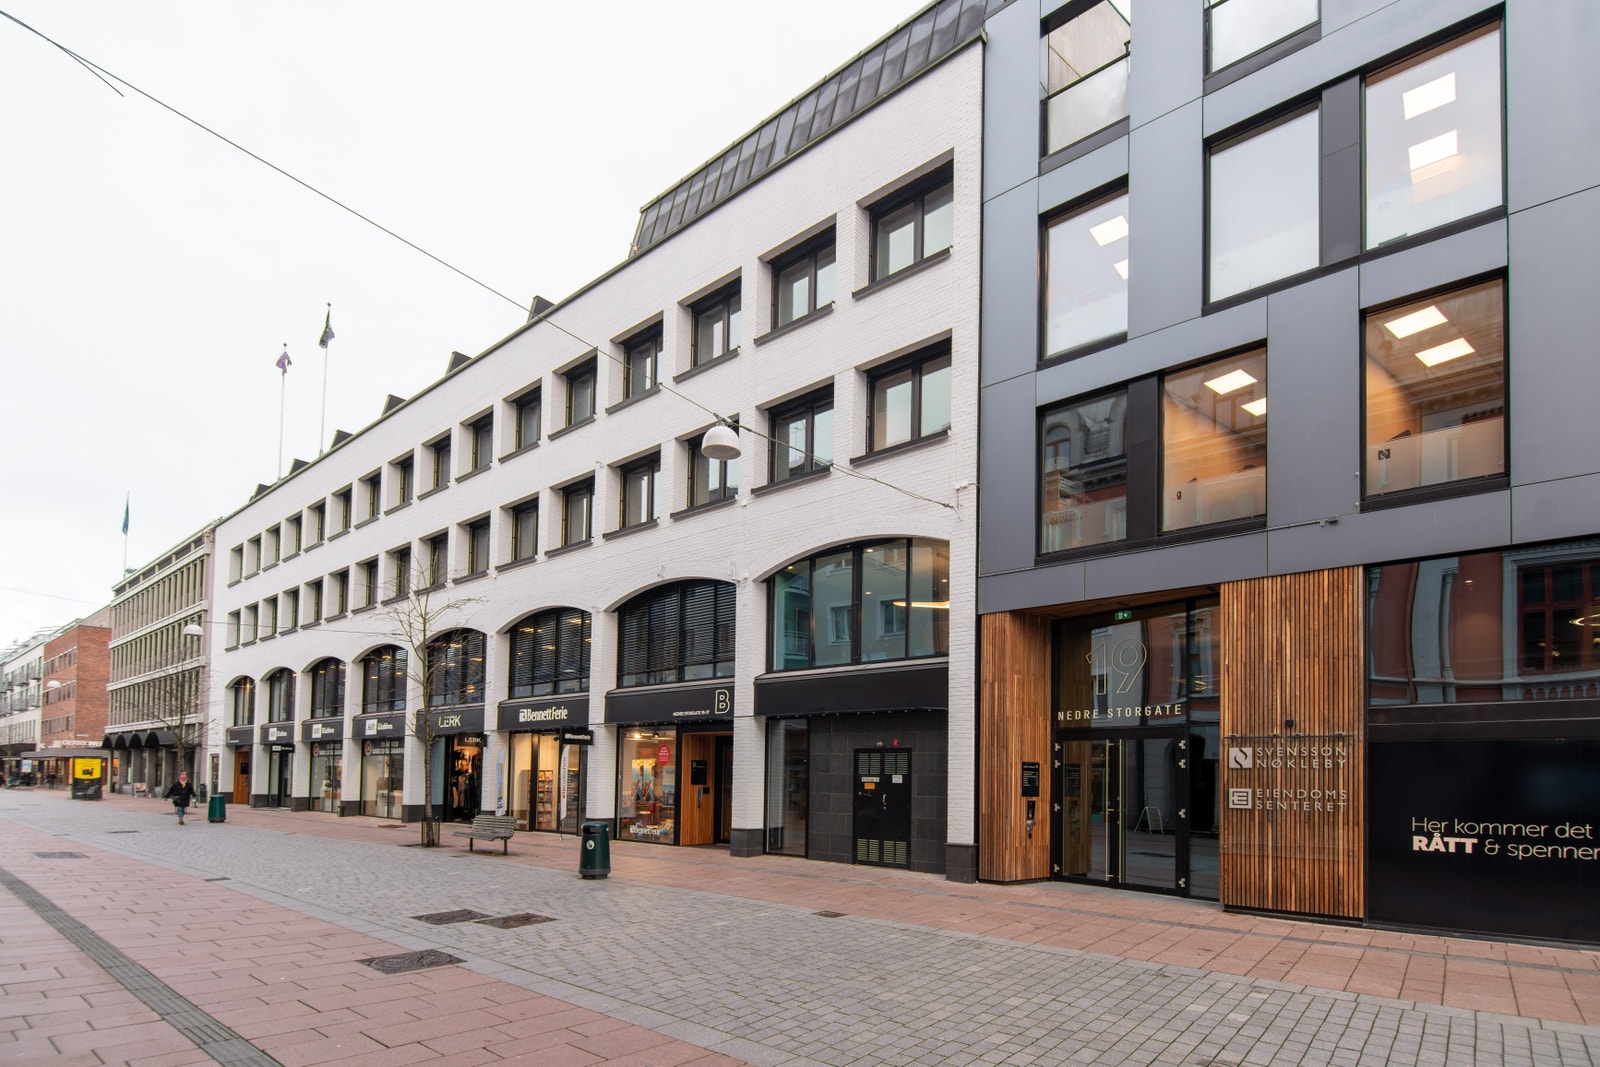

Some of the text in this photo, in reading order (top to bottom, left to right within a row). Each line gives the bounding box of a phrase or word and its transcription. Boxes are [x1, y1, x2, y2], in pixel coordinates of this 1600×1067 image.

[1085, 638, 1147, 695] 19
[715, 690, 730, 714] B
[1057, 704, 1182, 721] NEDRE STORGATE
[438, 715, 461, 728] LERK
[1257, 746, 1347, 757] SVENSSON
[1257, 759, 1346, 769] NØKLEBY
[1257, 788, 1347, 800] EIENDOMS
[1256, 800, 1347, 812] SENTERET
[1412, 816, 1594, 839] Her kommer det
[1412, 832, 1478, 854] RÅTT
[1484, 838, 1501, 856] &
